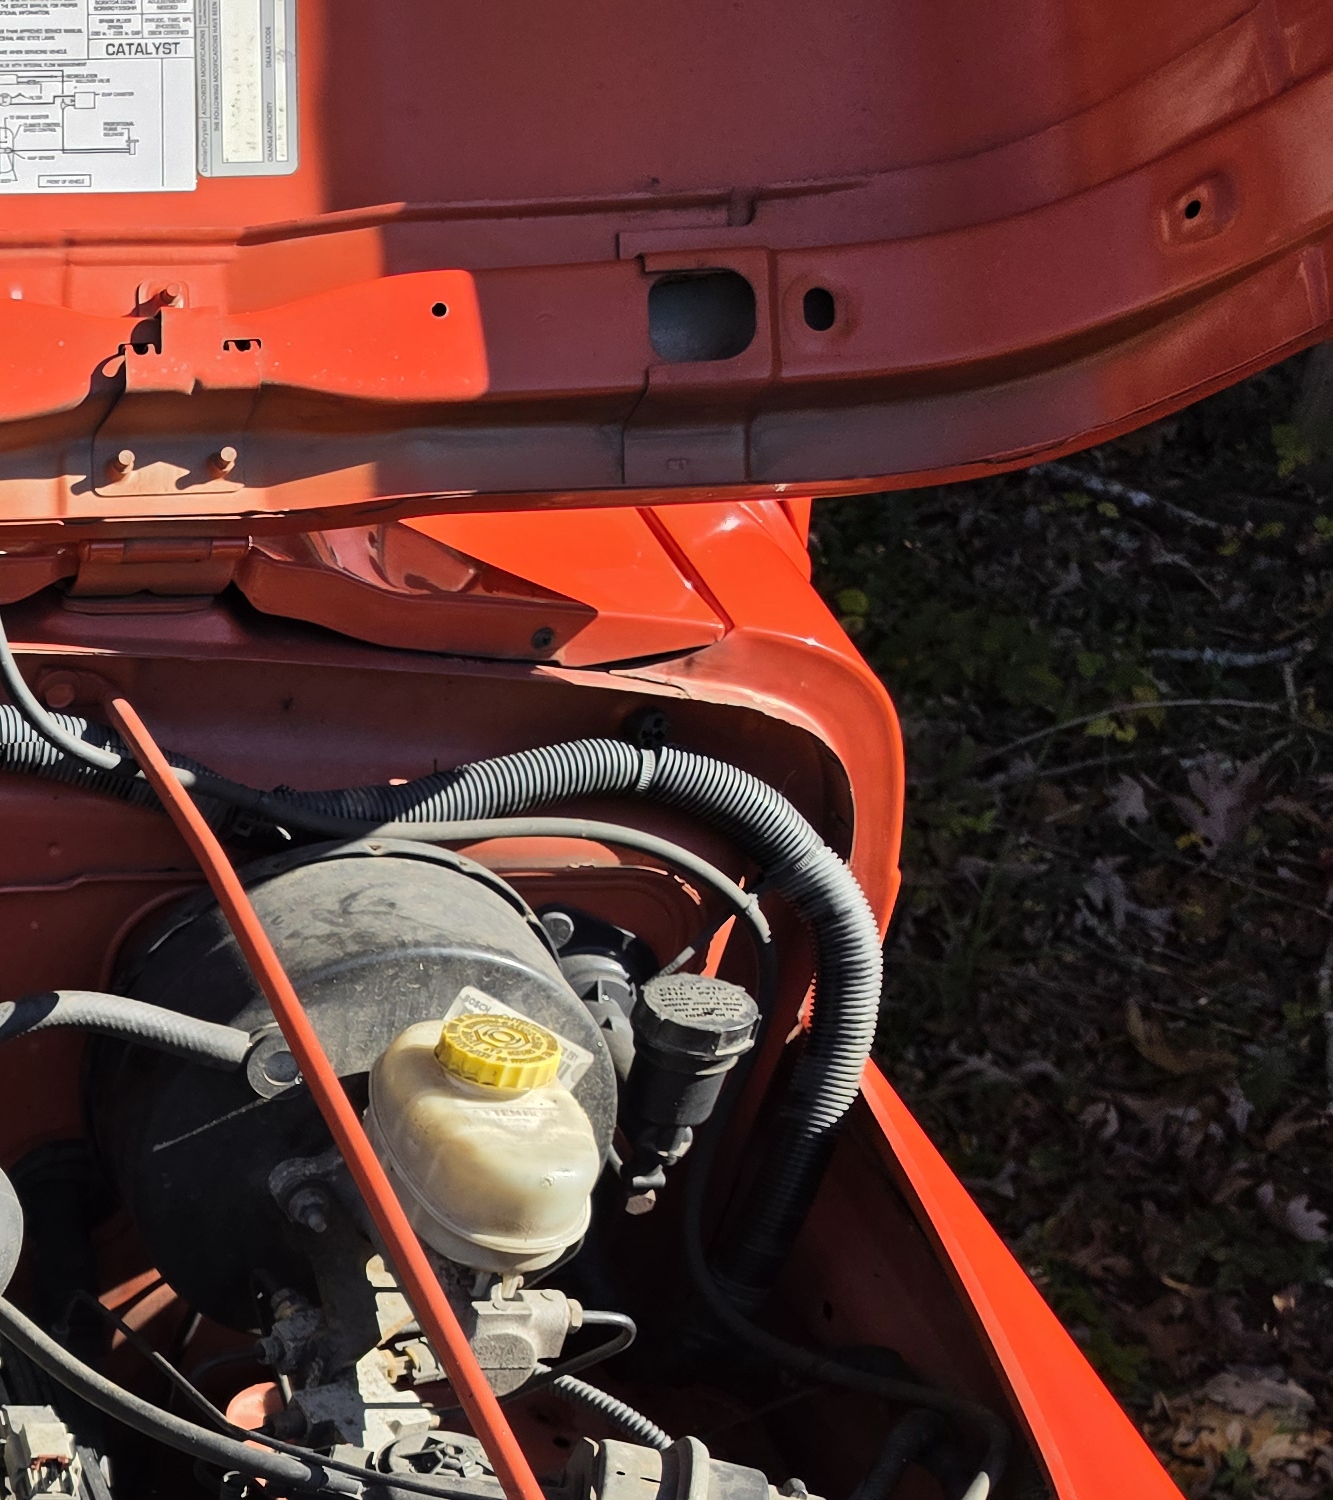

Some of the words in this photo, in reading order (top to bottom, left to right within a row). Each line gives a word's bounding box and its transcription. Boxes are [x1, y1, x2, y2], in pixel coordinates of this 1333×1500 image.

[105, 42, 181, 57] CATALYST
[201, 120, 210, 173] DaimlerChrysler
[266, 135, 274, 162] CHANGE
